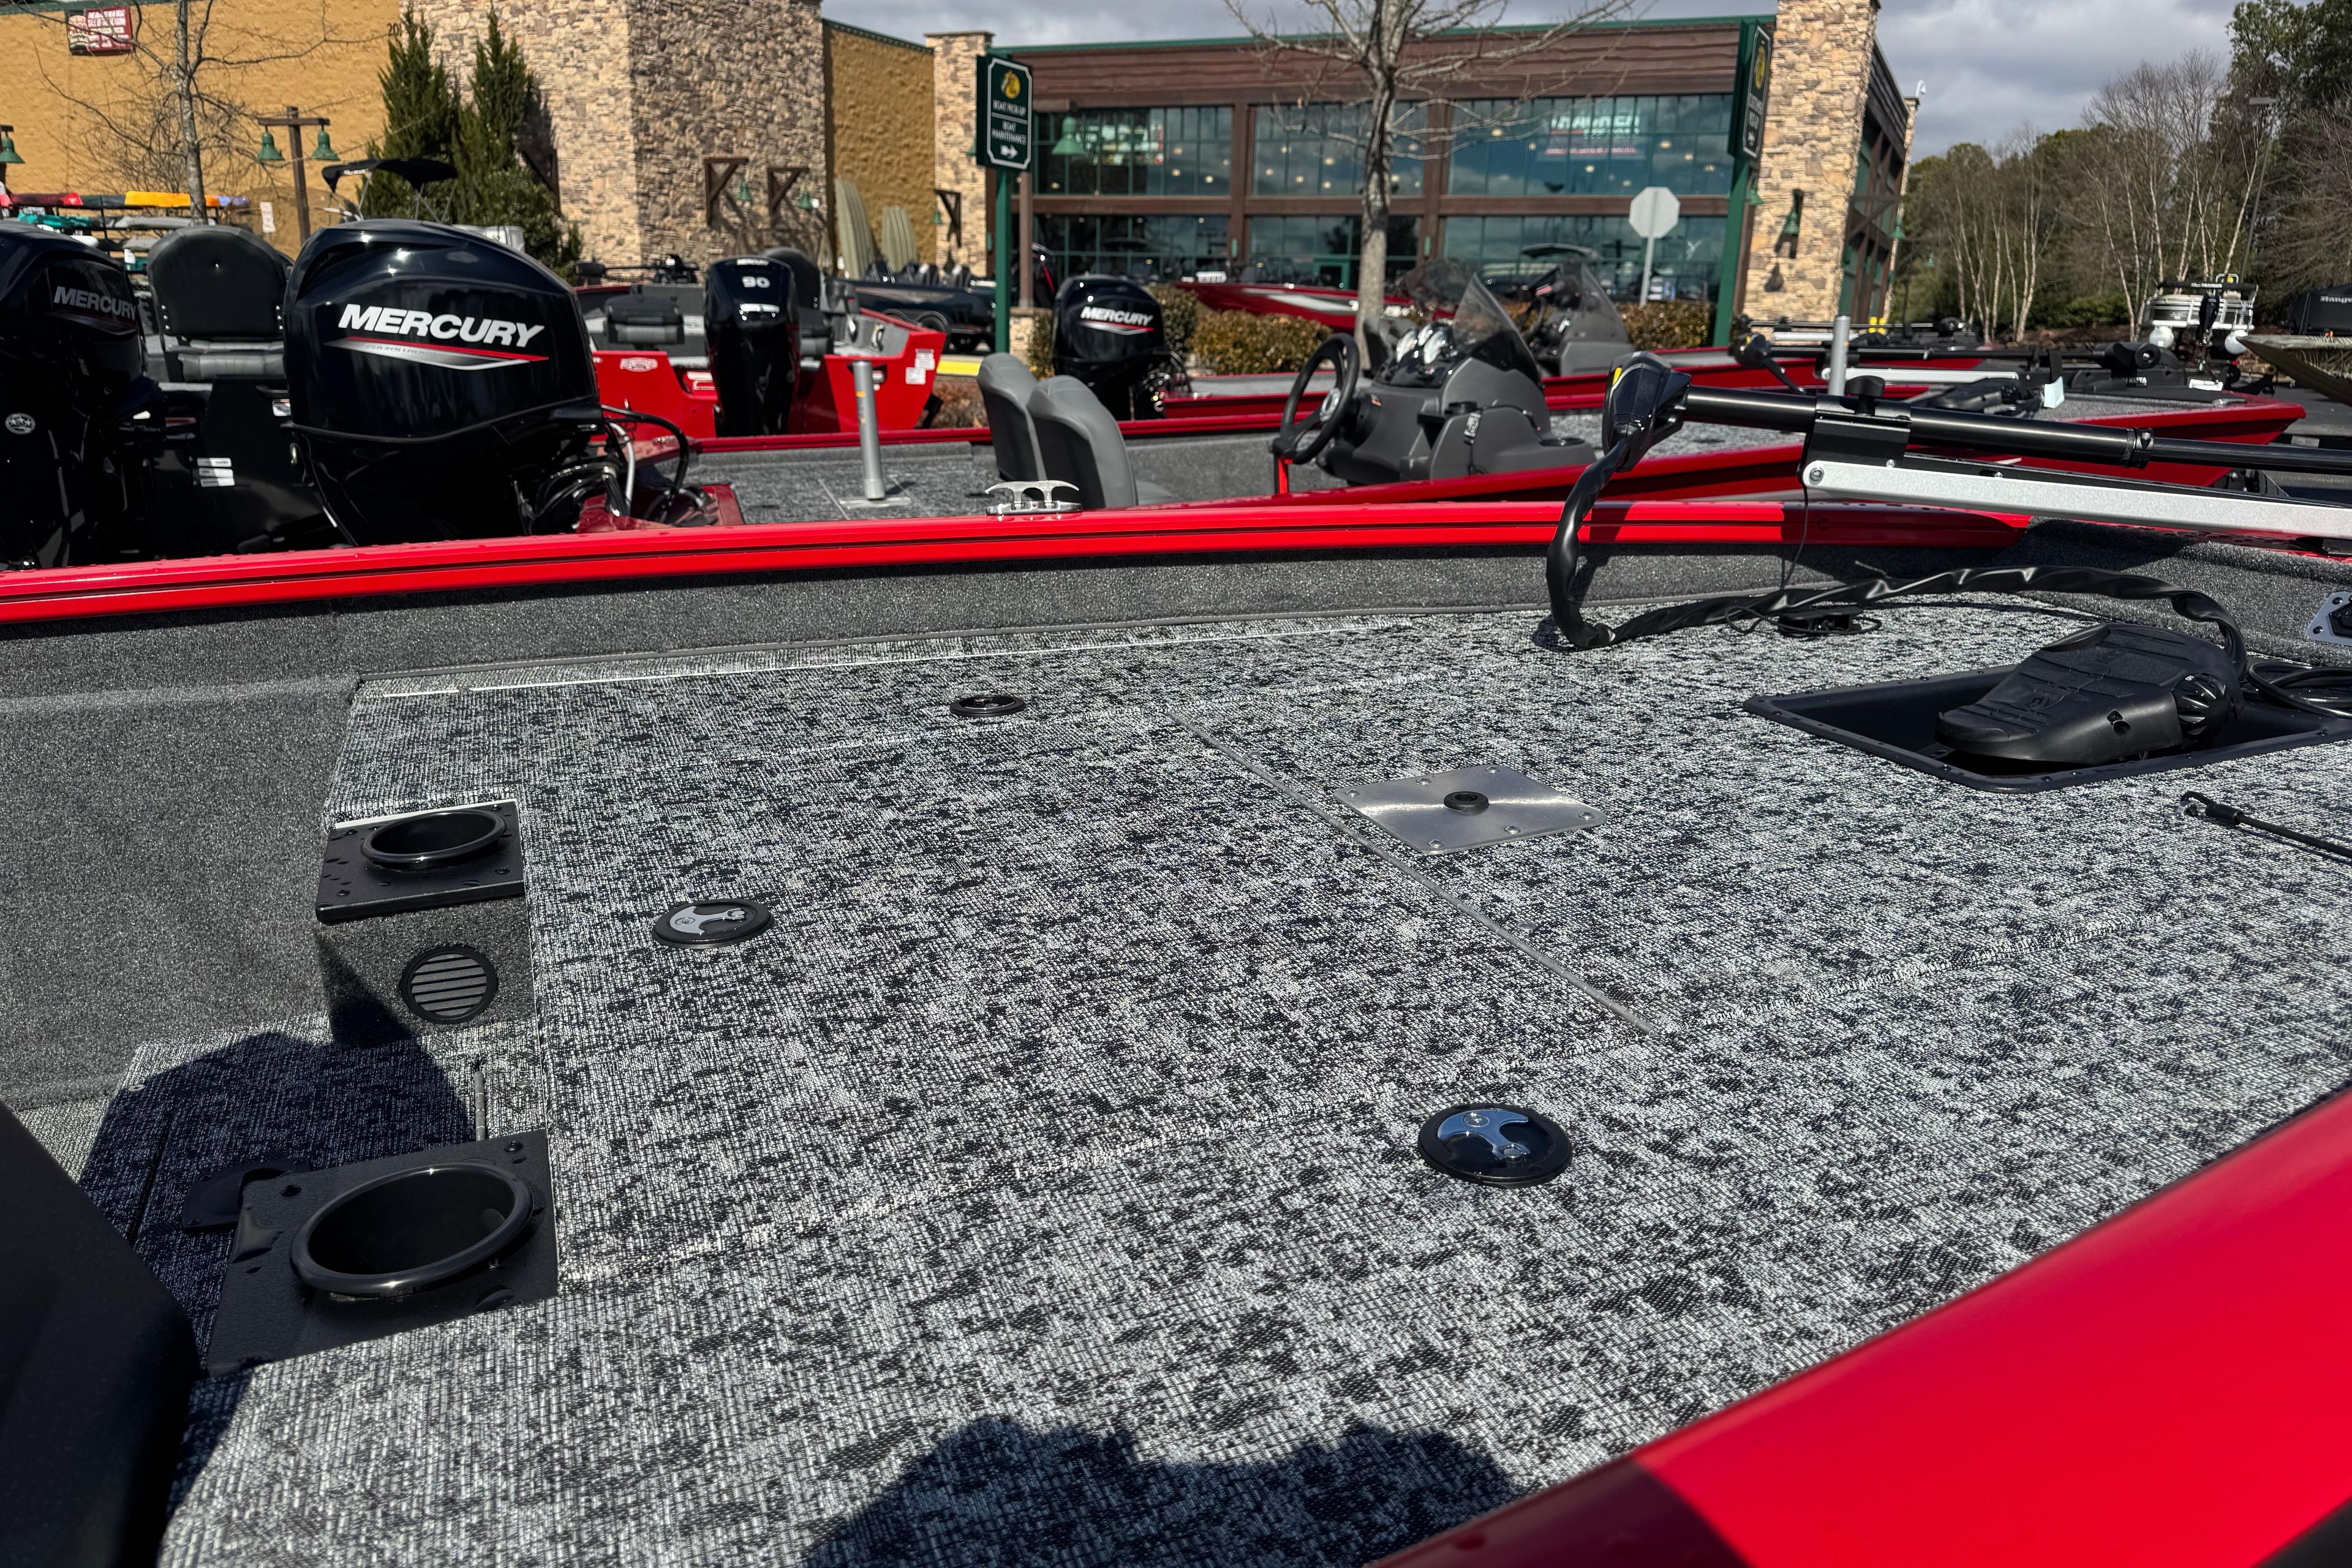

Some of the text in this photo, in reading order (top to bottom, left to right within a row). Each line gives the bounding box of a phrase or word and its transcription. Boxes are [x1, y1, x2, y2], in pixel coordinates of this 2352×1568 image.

[742, 276, 771, 288] 90
[54, 285, 136, 322] MERCURY
[1080, 306, 1153, 326] MERCURY
[338, 303, 545, 347] MERCURY
